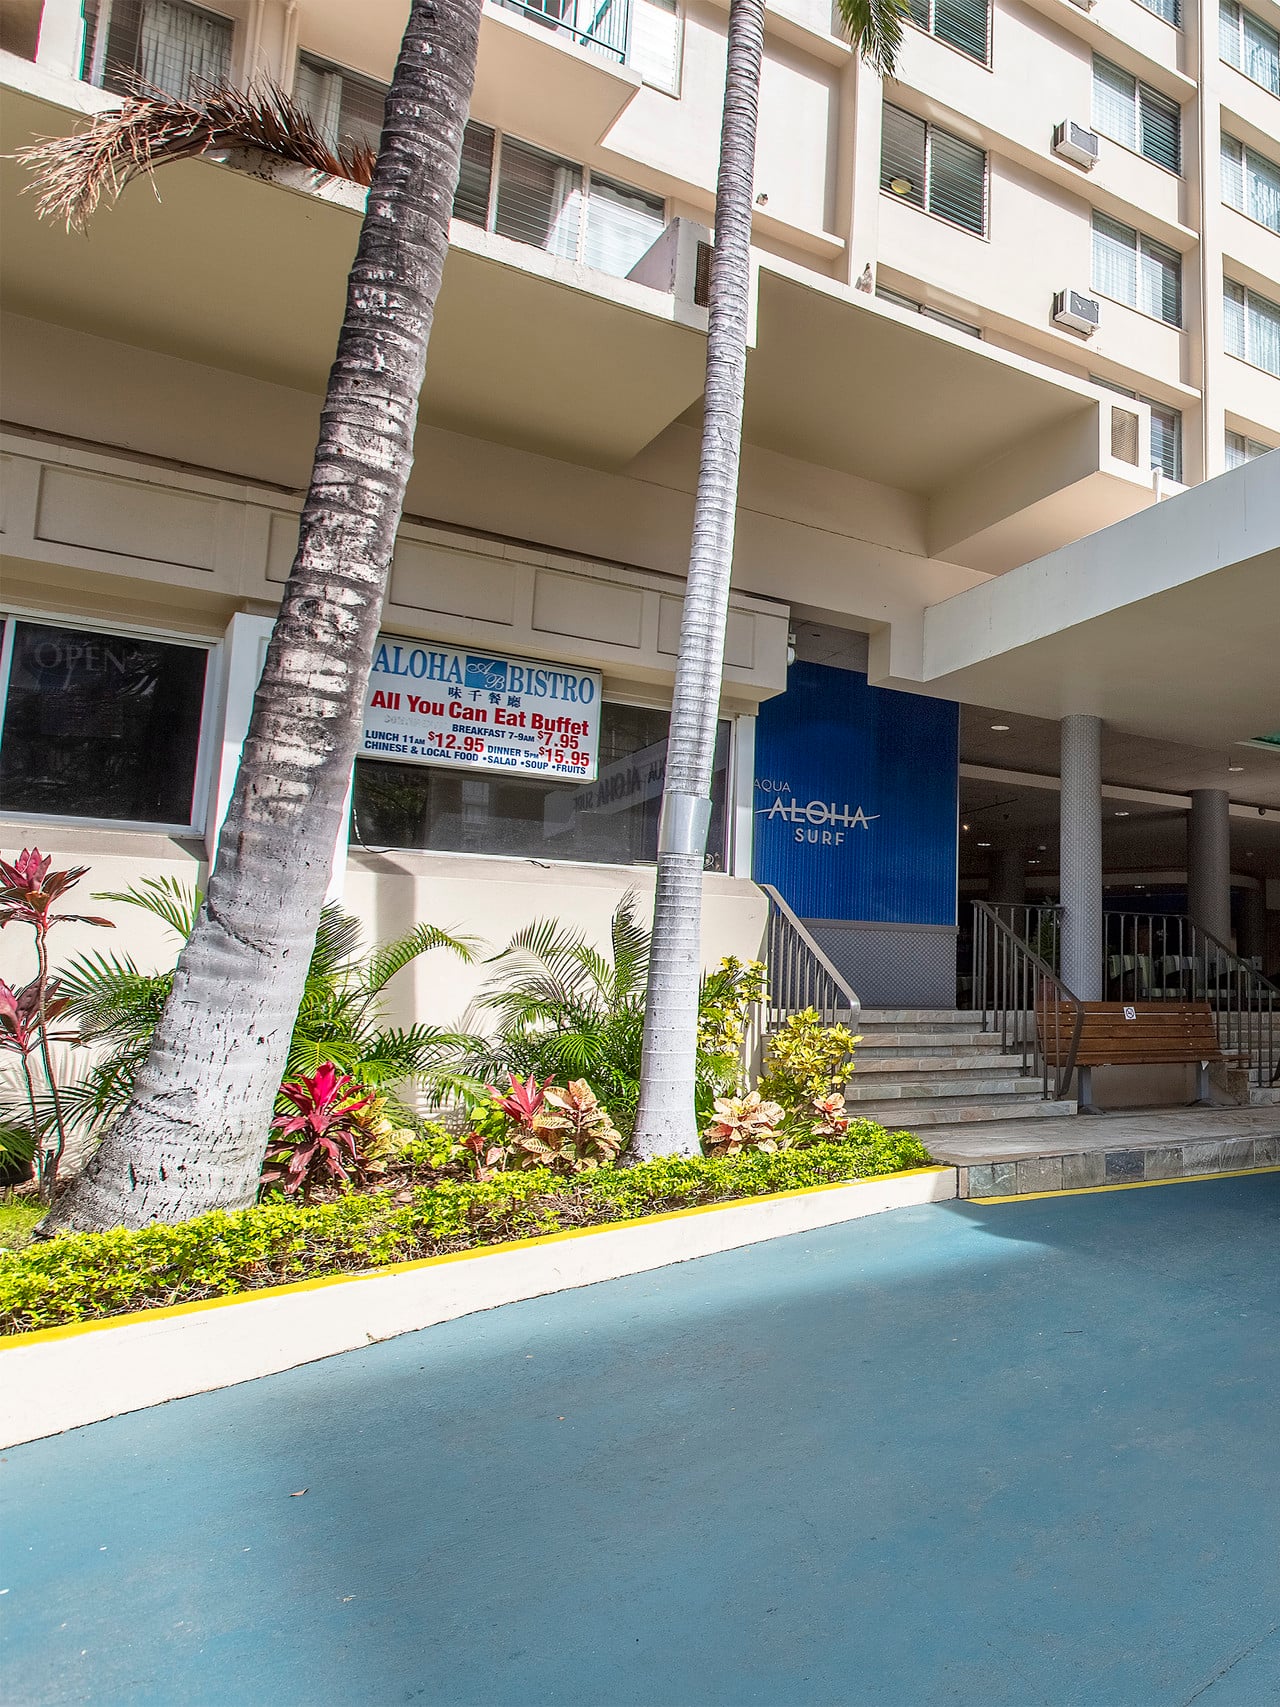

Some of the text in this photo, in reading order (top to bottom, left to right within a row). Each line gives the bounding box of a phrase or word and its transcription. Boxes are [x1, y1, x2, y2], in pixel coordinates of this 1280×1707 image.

[34, 641, 126, 675] OPEN
[371, 643, 595, 705] ALOHA BISTRO
[370, 690, 401, 711] All
[406, 694, 445, 717] You
[448, 701, 488, 723] Can
[494, 707, 527, 728] Eat
[530, 712, 590, 737] Buffet
[364, 740, 408, 754] CHINESE
[410, 745, 418, 755] &
[421, 747, 451, 759] LOCAL
[454, 751, 479, 762] FOOD
[365, 729, 590, 767] LUNCH 11AM $12.95 DINNER 5PM $15.95
[452, 723, 579, 750] BREAKFAST 7-9AM $7.95
[753, 777, 791, 793] AQUA
[767, 796, 869, 830] ALOHA
[794, 827, 846, 846] SURF
